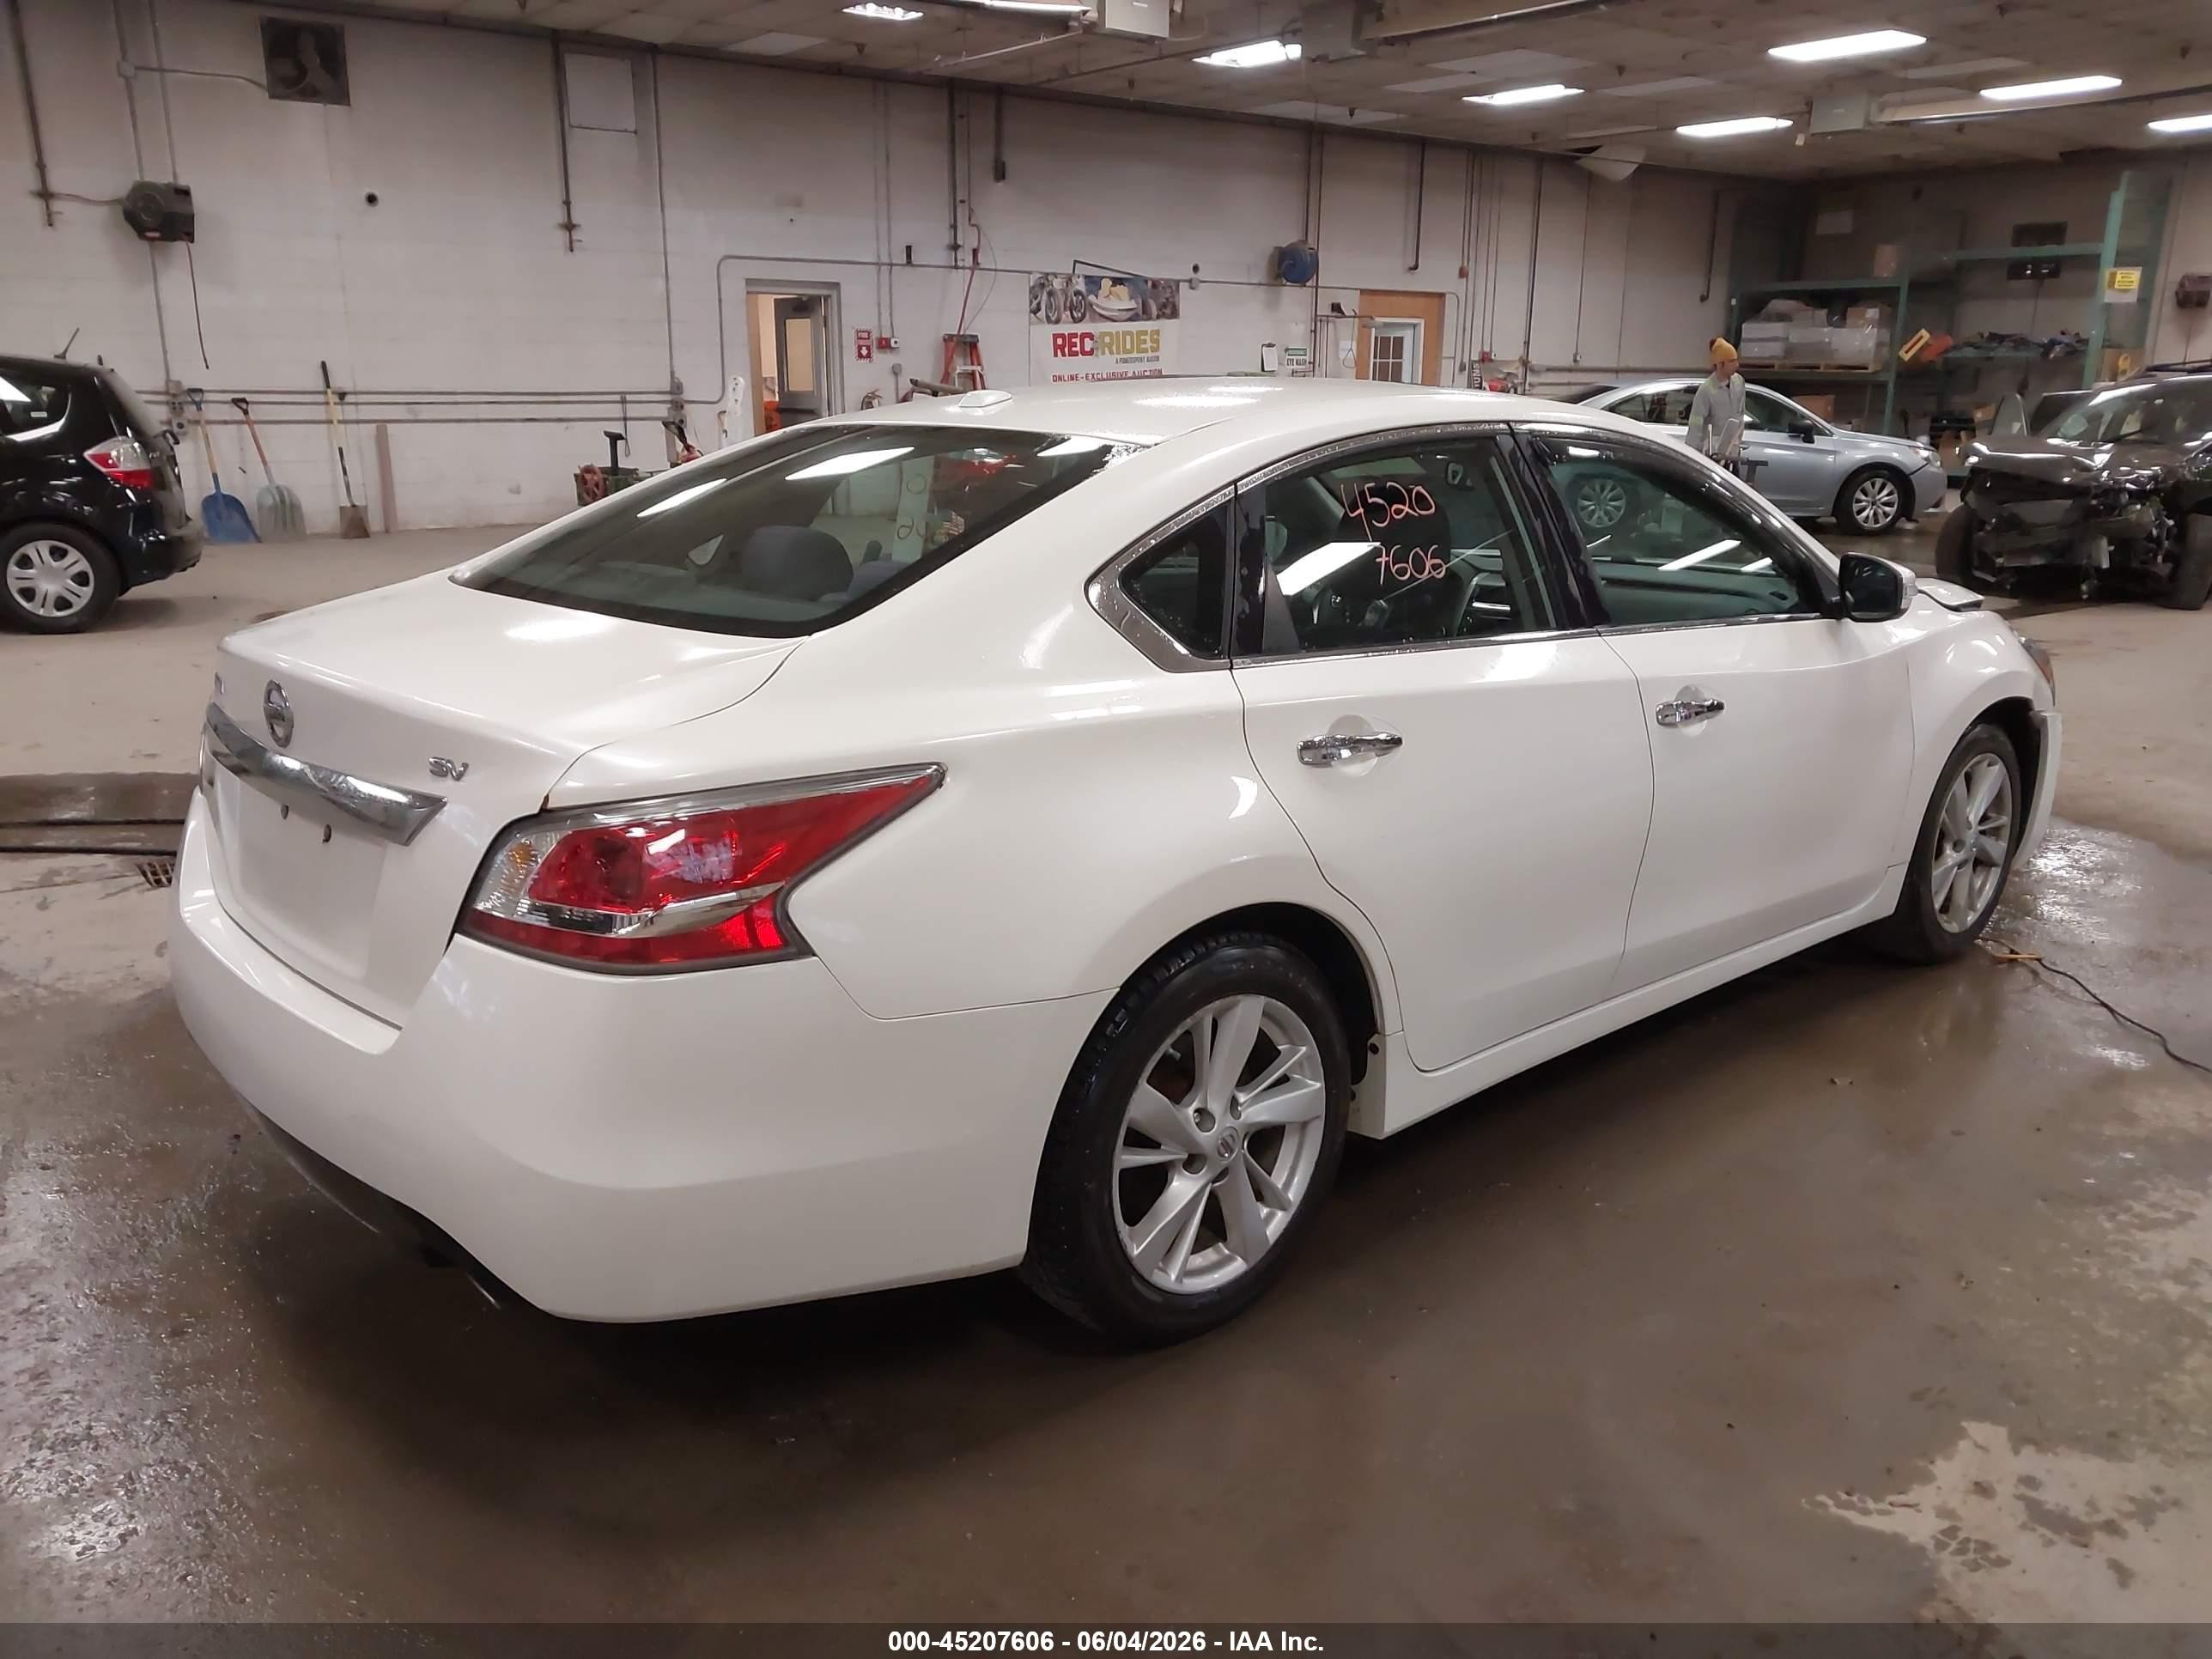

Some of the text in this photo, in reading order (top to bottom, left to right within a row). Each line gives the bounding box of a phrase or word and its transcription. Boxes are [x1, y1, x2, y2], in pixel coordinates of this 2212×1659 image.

[1052, 329, 1160, 357] REC RIDES
[1340, 481, 1436, 542] 4520
[1367, 544, 1447, 586] 7606
[428, 757, 469, 781] SV
